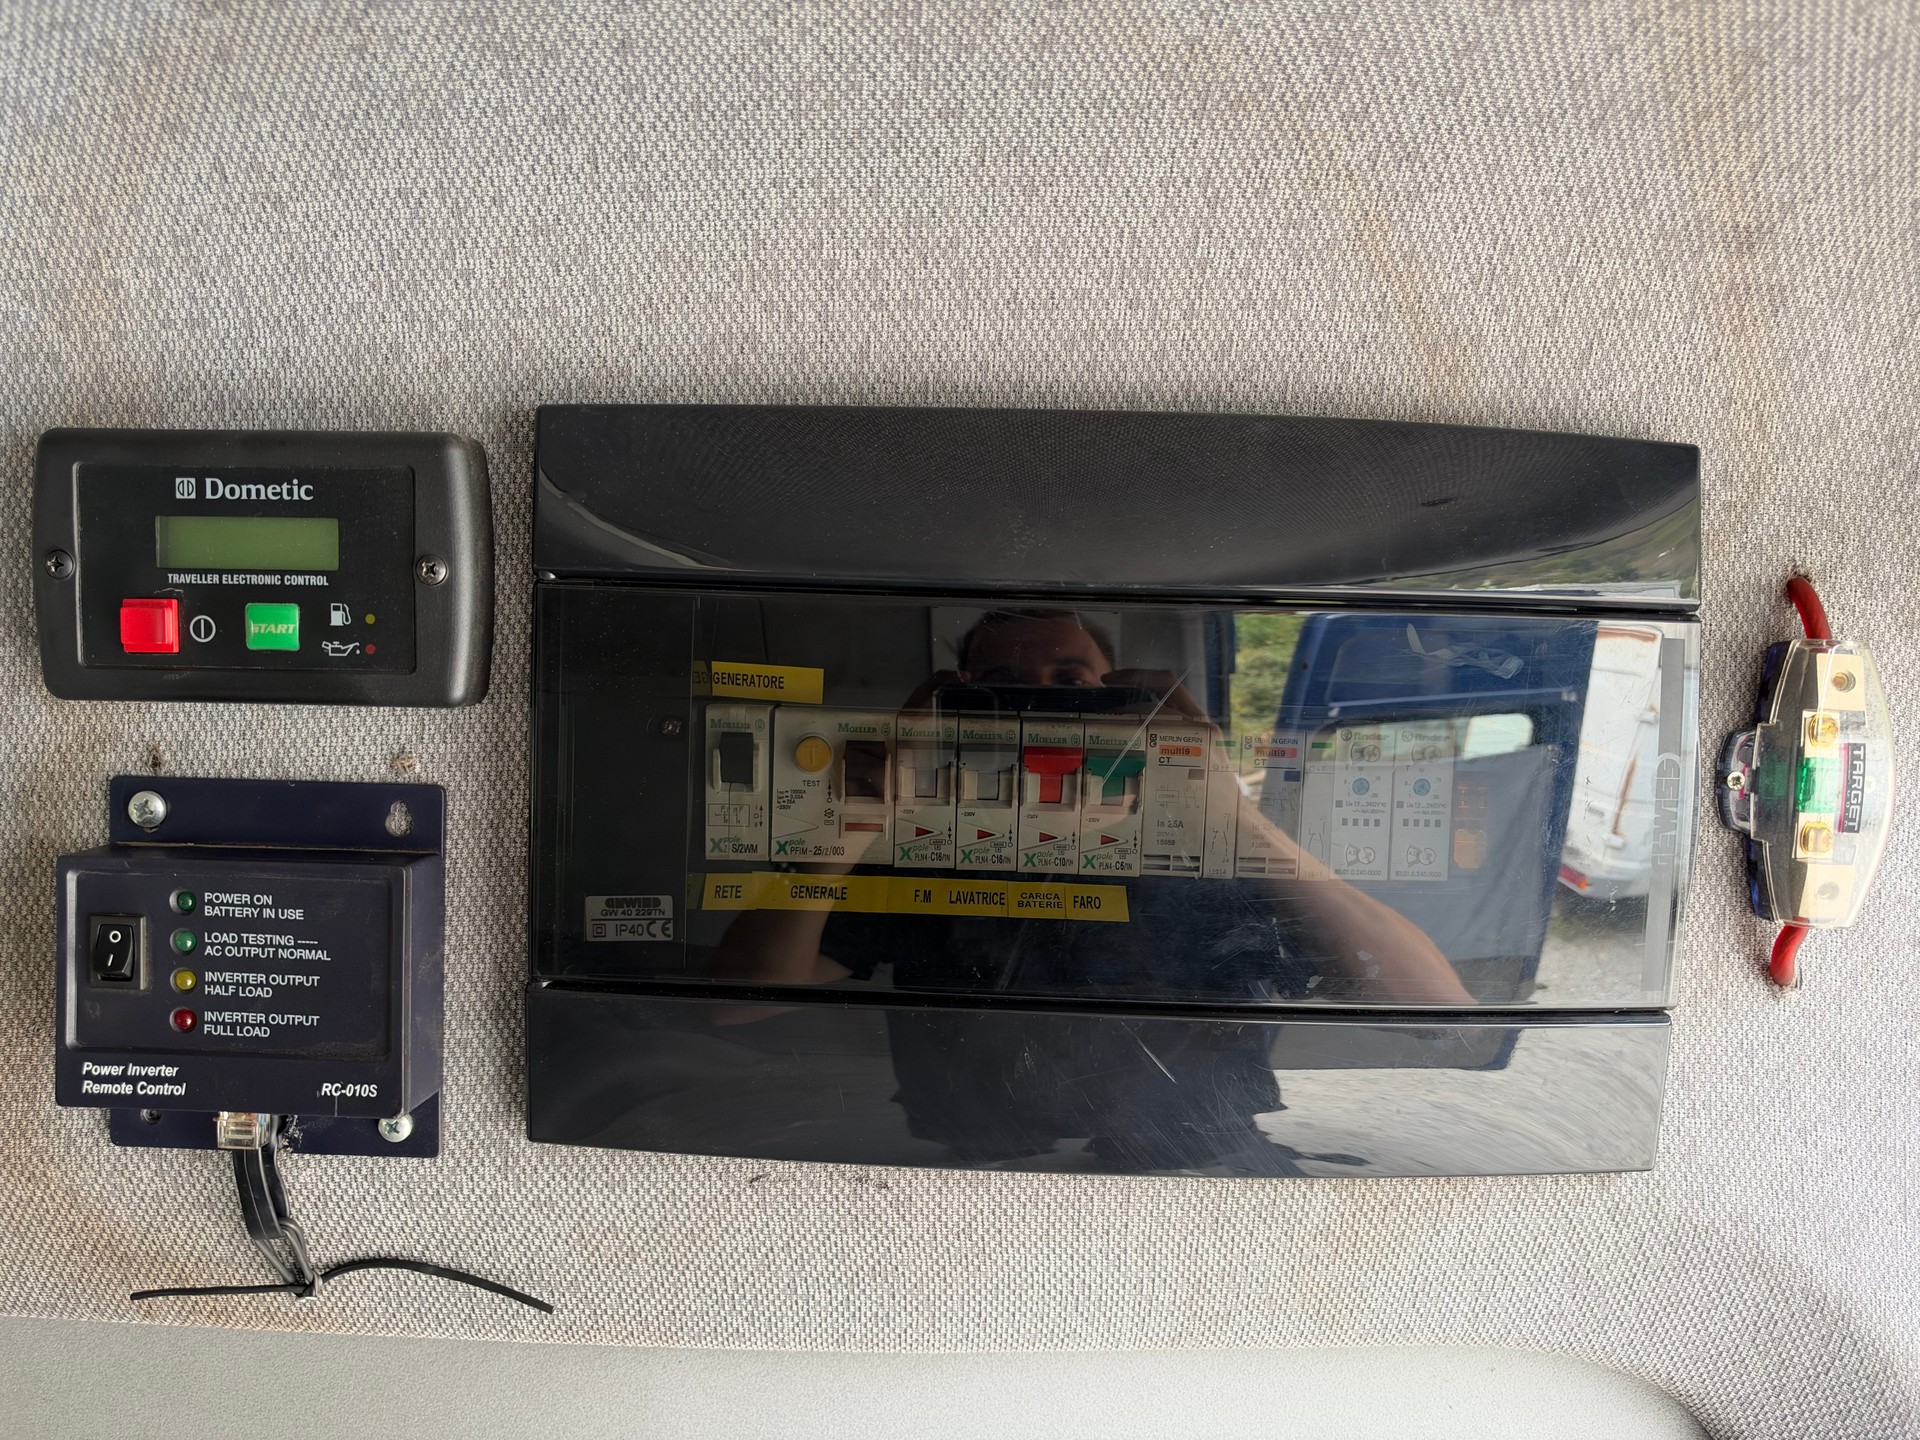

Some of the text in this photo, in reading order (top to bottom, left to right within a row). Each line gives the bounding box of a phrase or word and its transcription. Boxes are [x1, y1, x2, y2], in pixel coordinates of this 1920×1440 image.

[205, 478, 314, 501] Dometic
[167, 573, 329, 587] TRAVELLER ELECTRONIC CONTROL
[251, 623, 297, 634] START
[713, 672, 785, 690] GENERATORE
[1278, 738, 1298, 746] GERIN
[1161, 747, 1190, 755] multi9
[1158, 756, 1172, 764] CT
[1254, 758, 1267, 766] CT
[1847, 746, 1864, 831] TARGET
[1168, 820, 1184, 828] 25A
[714, 885, 742, 899] RETE
[790, 885, 848, 900] GENERALE
[914, 890, 932, 904] F.M
[949, 890, 1006, 906] LAVATRICE
[1020, 892, 1060, 900] CARICA
[204, 893, 273, 906] POWER ON
[1017, 900, 1064, 908] BATERIE
[1073, 895, 1101, 910] FARO
[204, 906, 304, 920] BATTERY IN USE
[601, 908, 618, 916] GW
[621, 908, 633, 916] 40
[615, 924, 644, 937] IP40
[204, 933, 238, 945] LOAD
[240, 934, 294, 946] TESTING
[204, 945, 331, 961] AC OUTPUT NORMAL
[204, 972, 320, 987] INVERTER OUTPUT
[204, 985, 272, 998] HALF LOAD
[204, 1011, 320, 1026] INVERTER OUTPUT
[204, 1025, 270, 1038] FULL LOAD
[82, 1062, 179, 1077] Power Inverter
[82, 1082, 186, 1096] Remote Control
[322, 1083, 378, 1098] RC-010S
